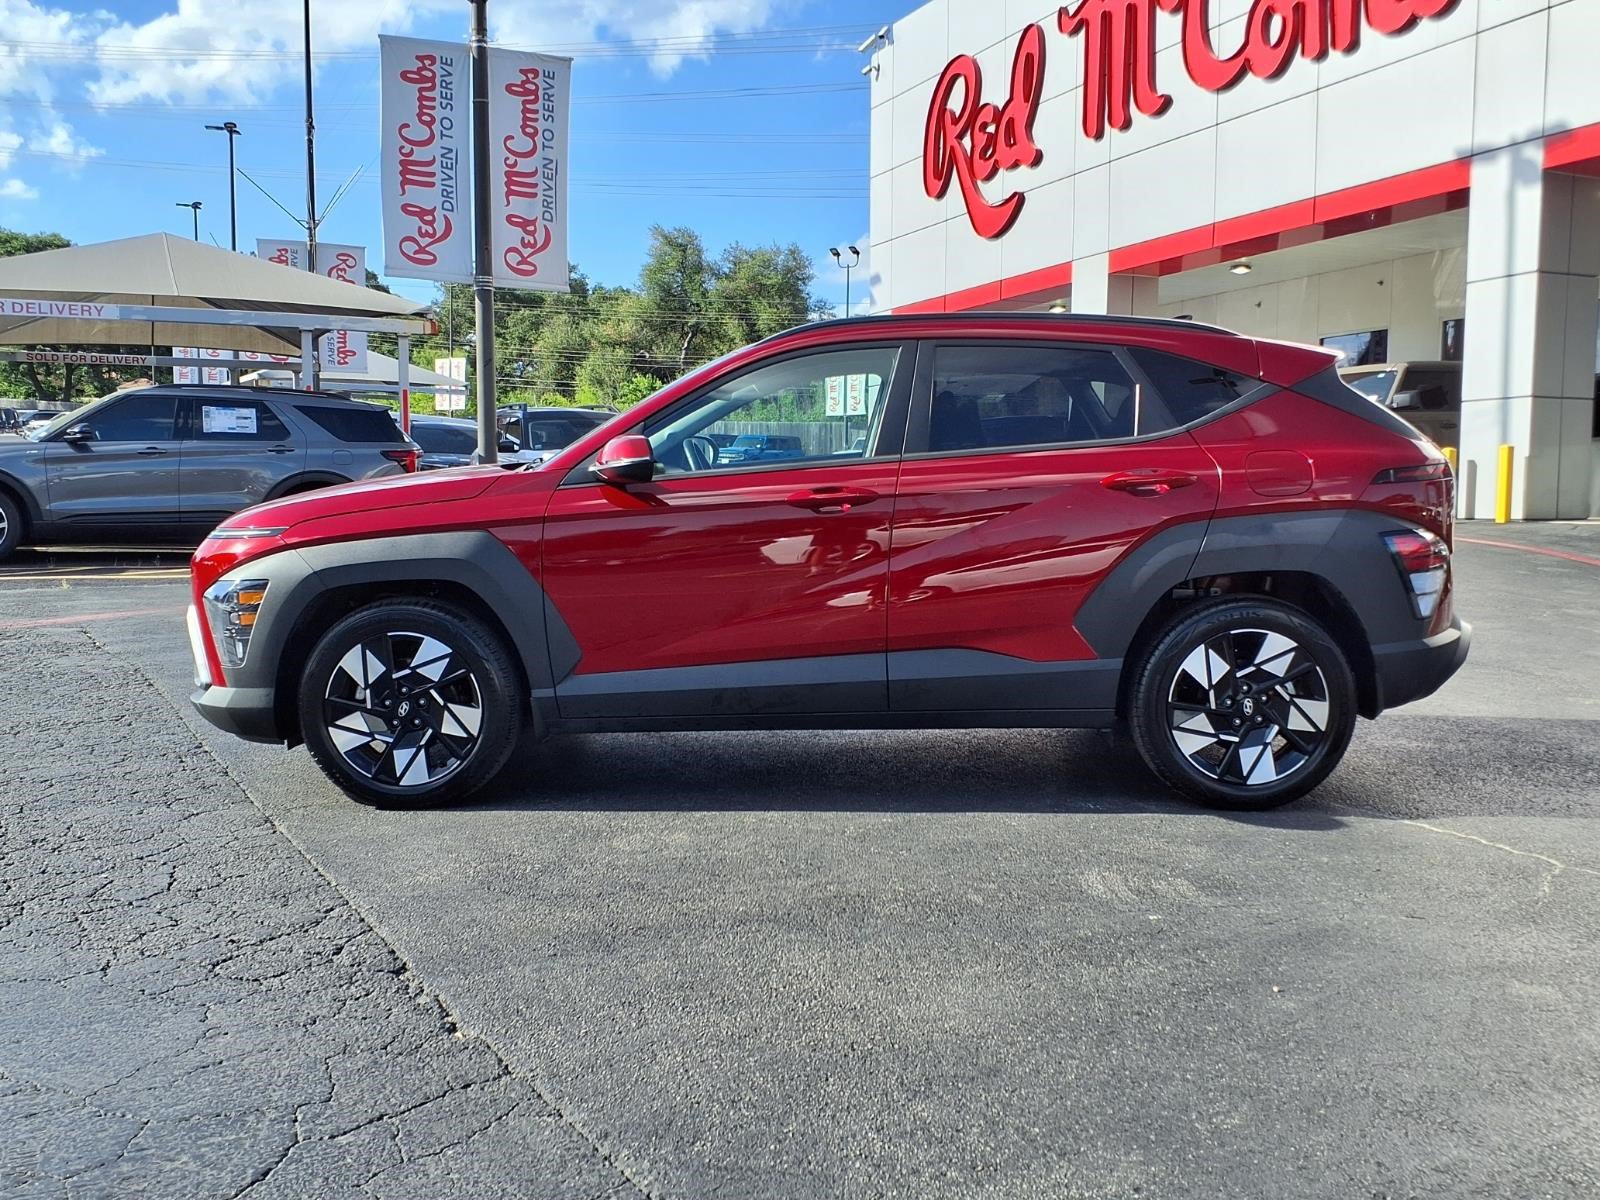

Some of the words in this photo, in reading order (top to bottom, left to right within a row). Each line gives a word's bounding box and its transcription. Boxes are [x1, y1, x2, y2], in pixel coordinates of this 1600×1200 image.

[440, 55, 454, 112] SERVE
[542, 69, 556, 123] SERVE
[398, 54, 438, 196] McCombs
[440, 117, 454, 144] TO
[503, 67, 540, 207] McCombs
[542, 128, 555, 154] TO
[923, 23, 1045, 240] Red
[1058, 0, 1465, 141] MCom
[440, 148, 455, 213] DRIVEN
[542, 158, 555, 223] DRIVEN
[290, 248, 299, 268] RVE
[399, 203, 453, 266] Red
[503, 213, 552, 277] Red
[12, 301, 105, 317] DELIVERY
[26, 352, 60, 362] SOLD
[62, 354, 87, 363] FOR
[90, 355, 147, 364] DELIVERY
[326, 336, 336, 366] SERVE
